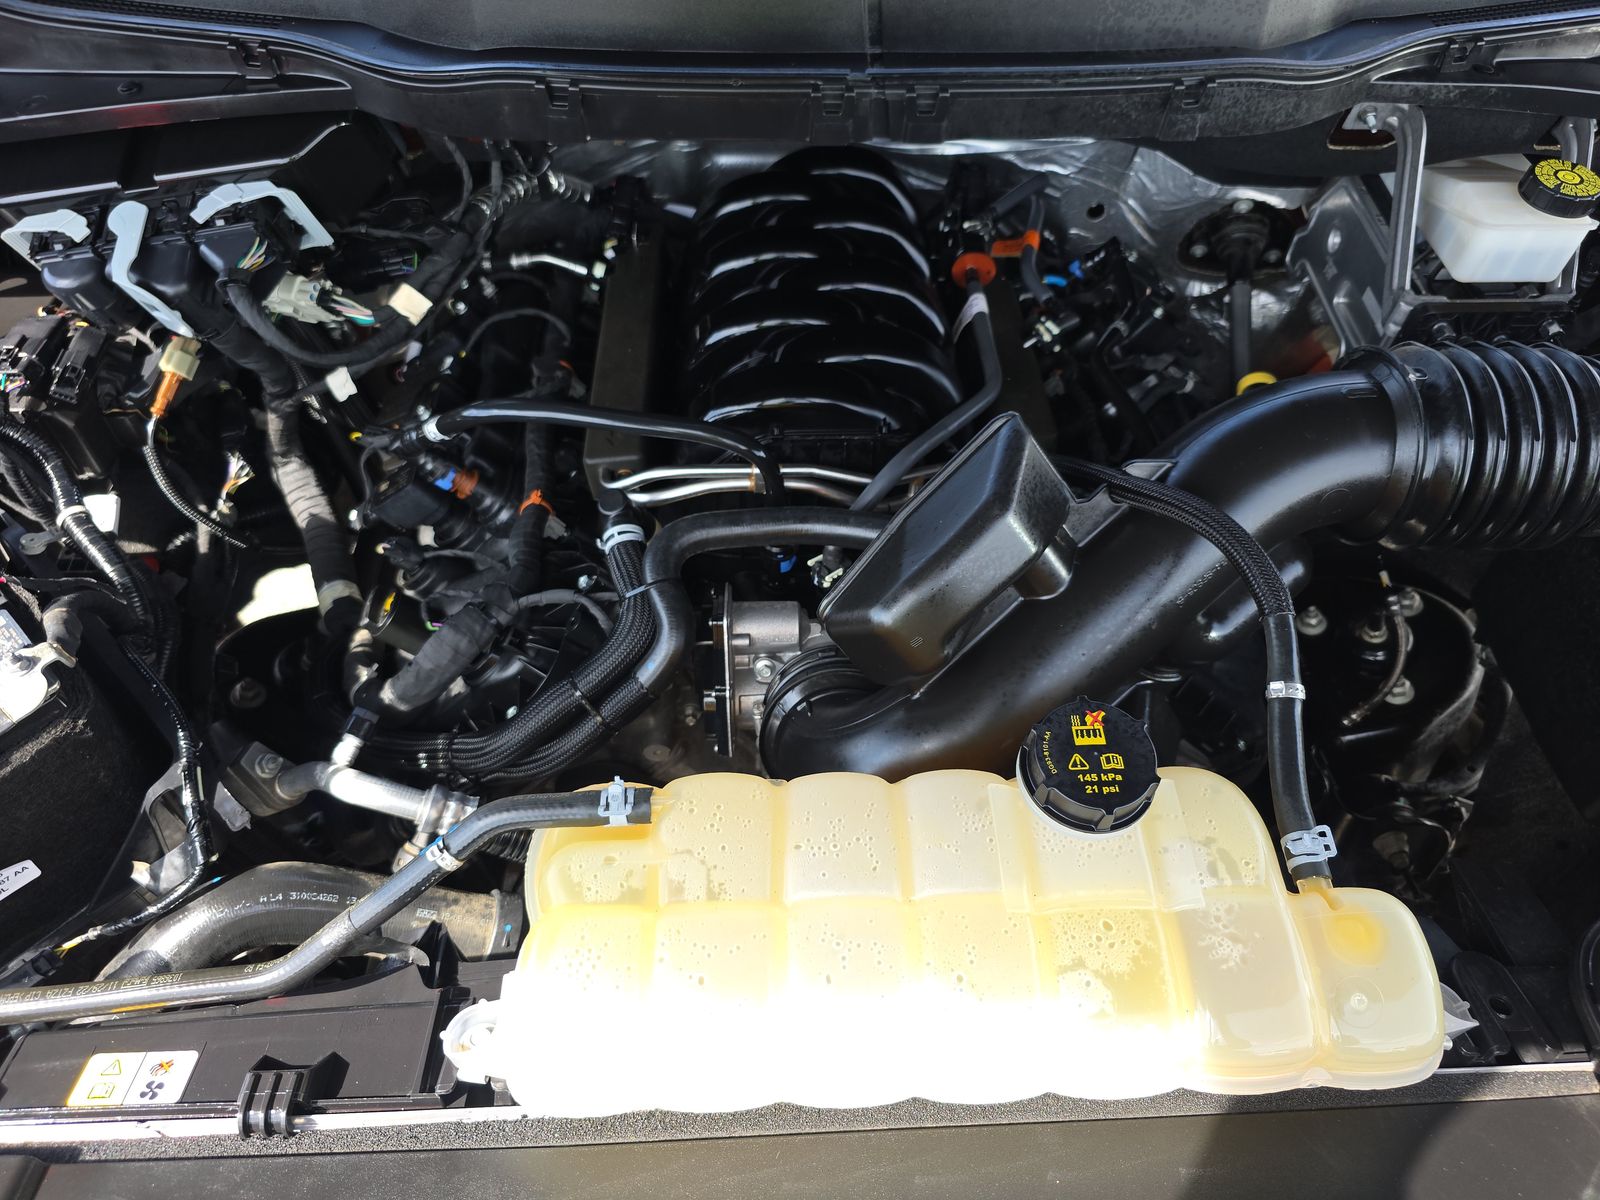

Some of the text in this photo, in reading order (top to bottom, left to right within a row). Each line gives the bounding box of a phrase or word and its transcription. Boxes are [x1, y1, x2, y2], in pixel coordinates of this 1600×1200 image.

[1077, 773, 1123, 782] 145 kPa
[1085, 785, 1120, 794] 21 psi
[15, 866, 29, 877] AA
